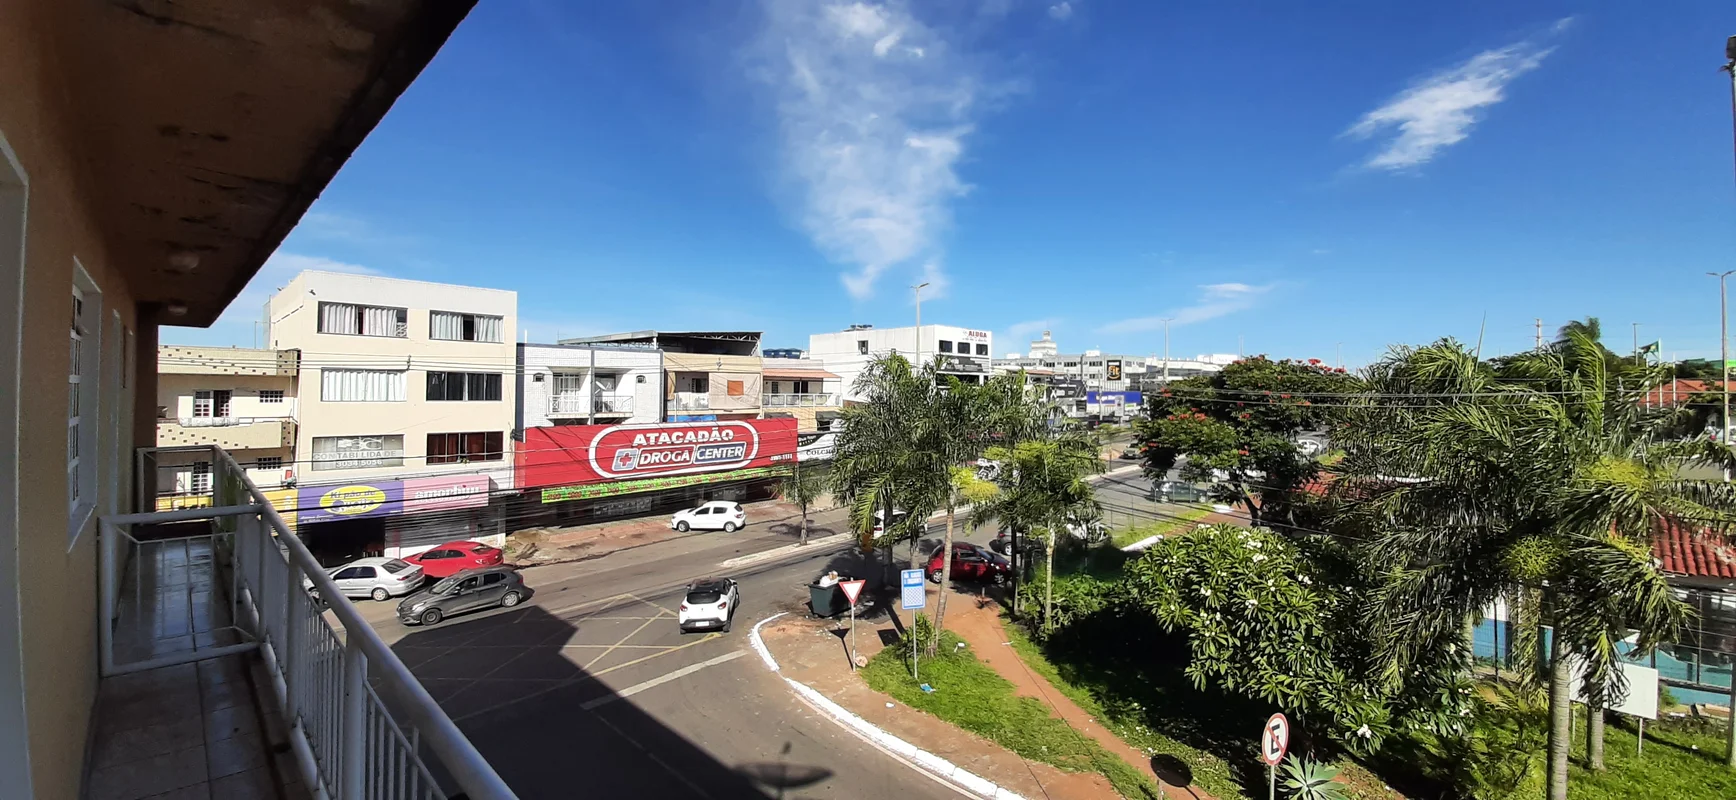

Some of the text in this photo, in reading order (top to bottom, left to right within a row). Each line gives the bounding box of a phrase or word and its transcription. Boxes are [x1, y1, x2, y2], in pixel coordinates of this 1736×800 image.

[632, 427, 734, 447] ATACADÃO
[639, 446, 743, 465] DROGA CENTER
